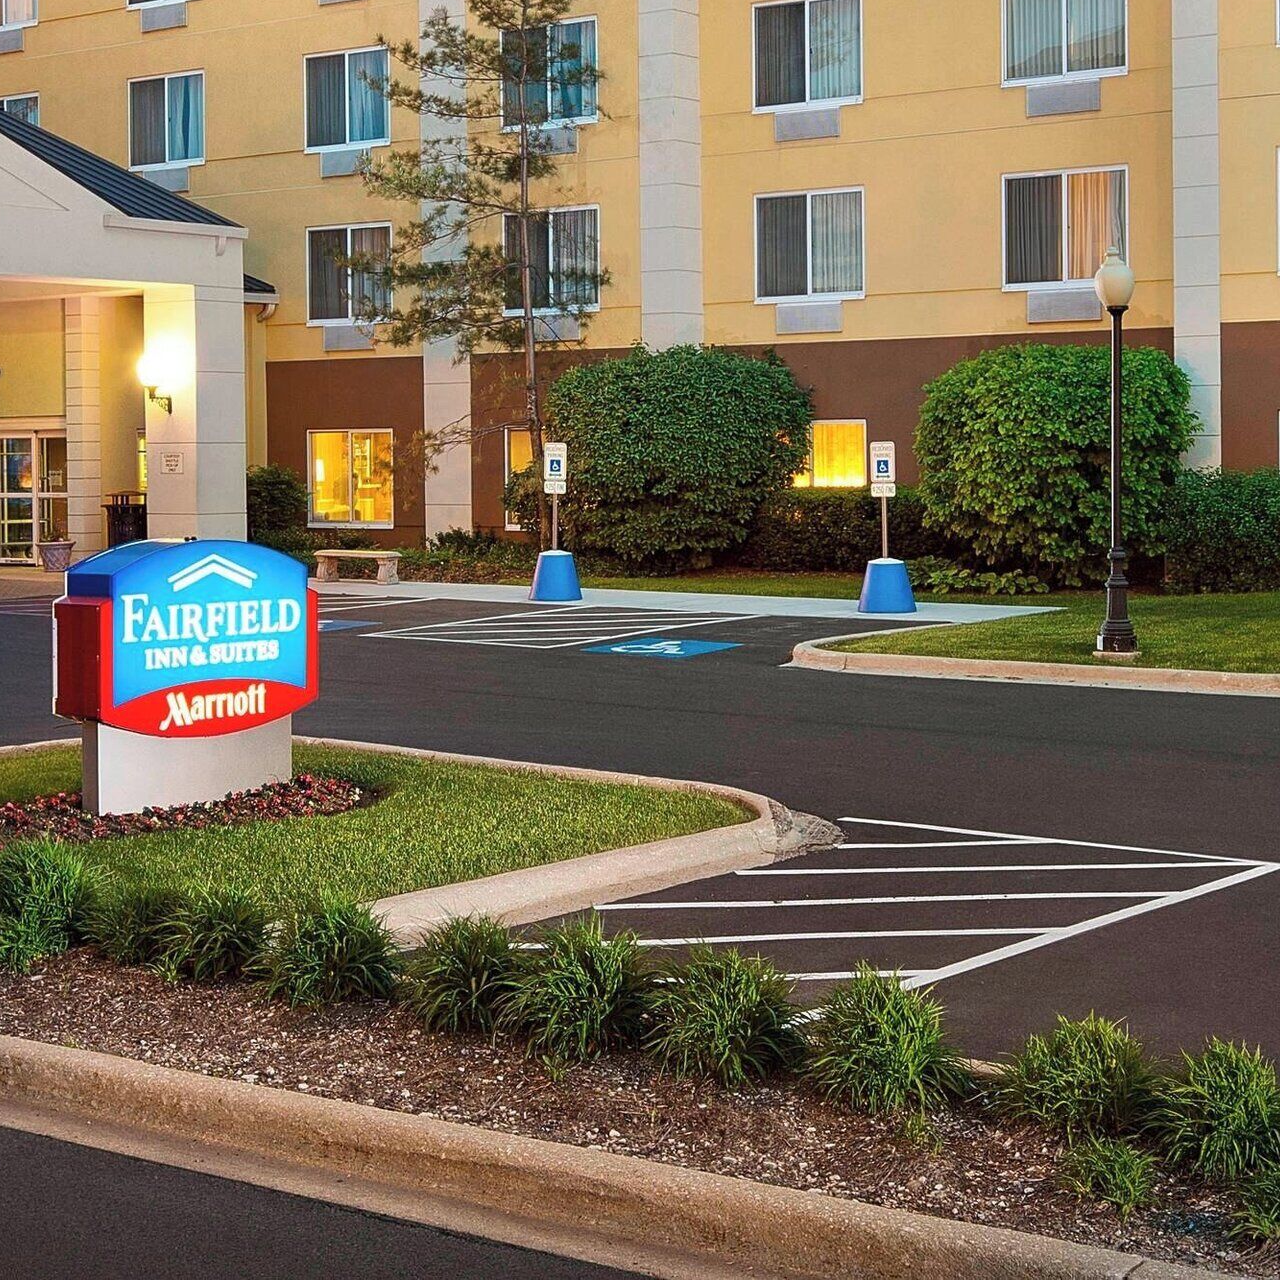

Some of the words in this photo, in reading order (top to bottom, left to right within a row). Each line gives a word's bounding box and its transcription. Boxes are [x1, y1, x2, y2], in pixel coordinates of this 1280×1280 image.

[121, 593, 301, 643] FAIRFIELD
[145, 645, 189, 670] INN
[189, 644, 208, 666] &
[209, 639, 280, 663] SUITES
[159, 683, 267, 731] Marriott
